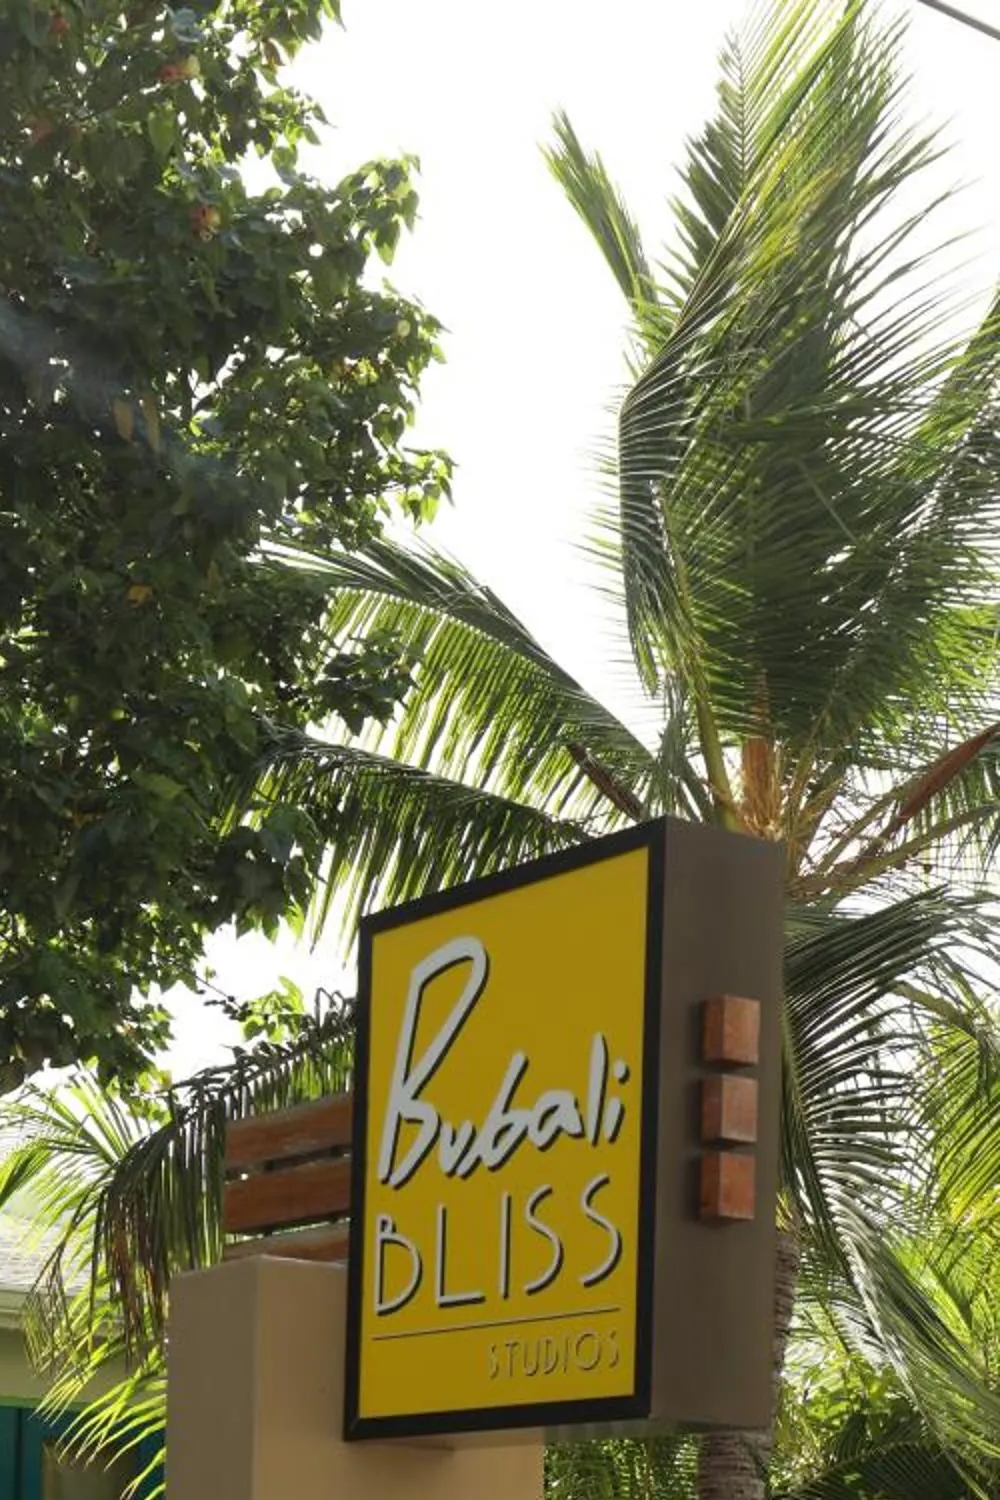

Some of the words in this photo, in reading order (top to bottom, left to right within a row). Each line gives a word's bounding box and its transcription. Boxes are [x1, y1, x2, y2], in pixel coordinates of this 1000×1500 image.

[377, 936, 629, 1189] Bubali
[376, 1173, 622, 1316] BLISS
[488, 1329, 619, 1379] STUDIOS
